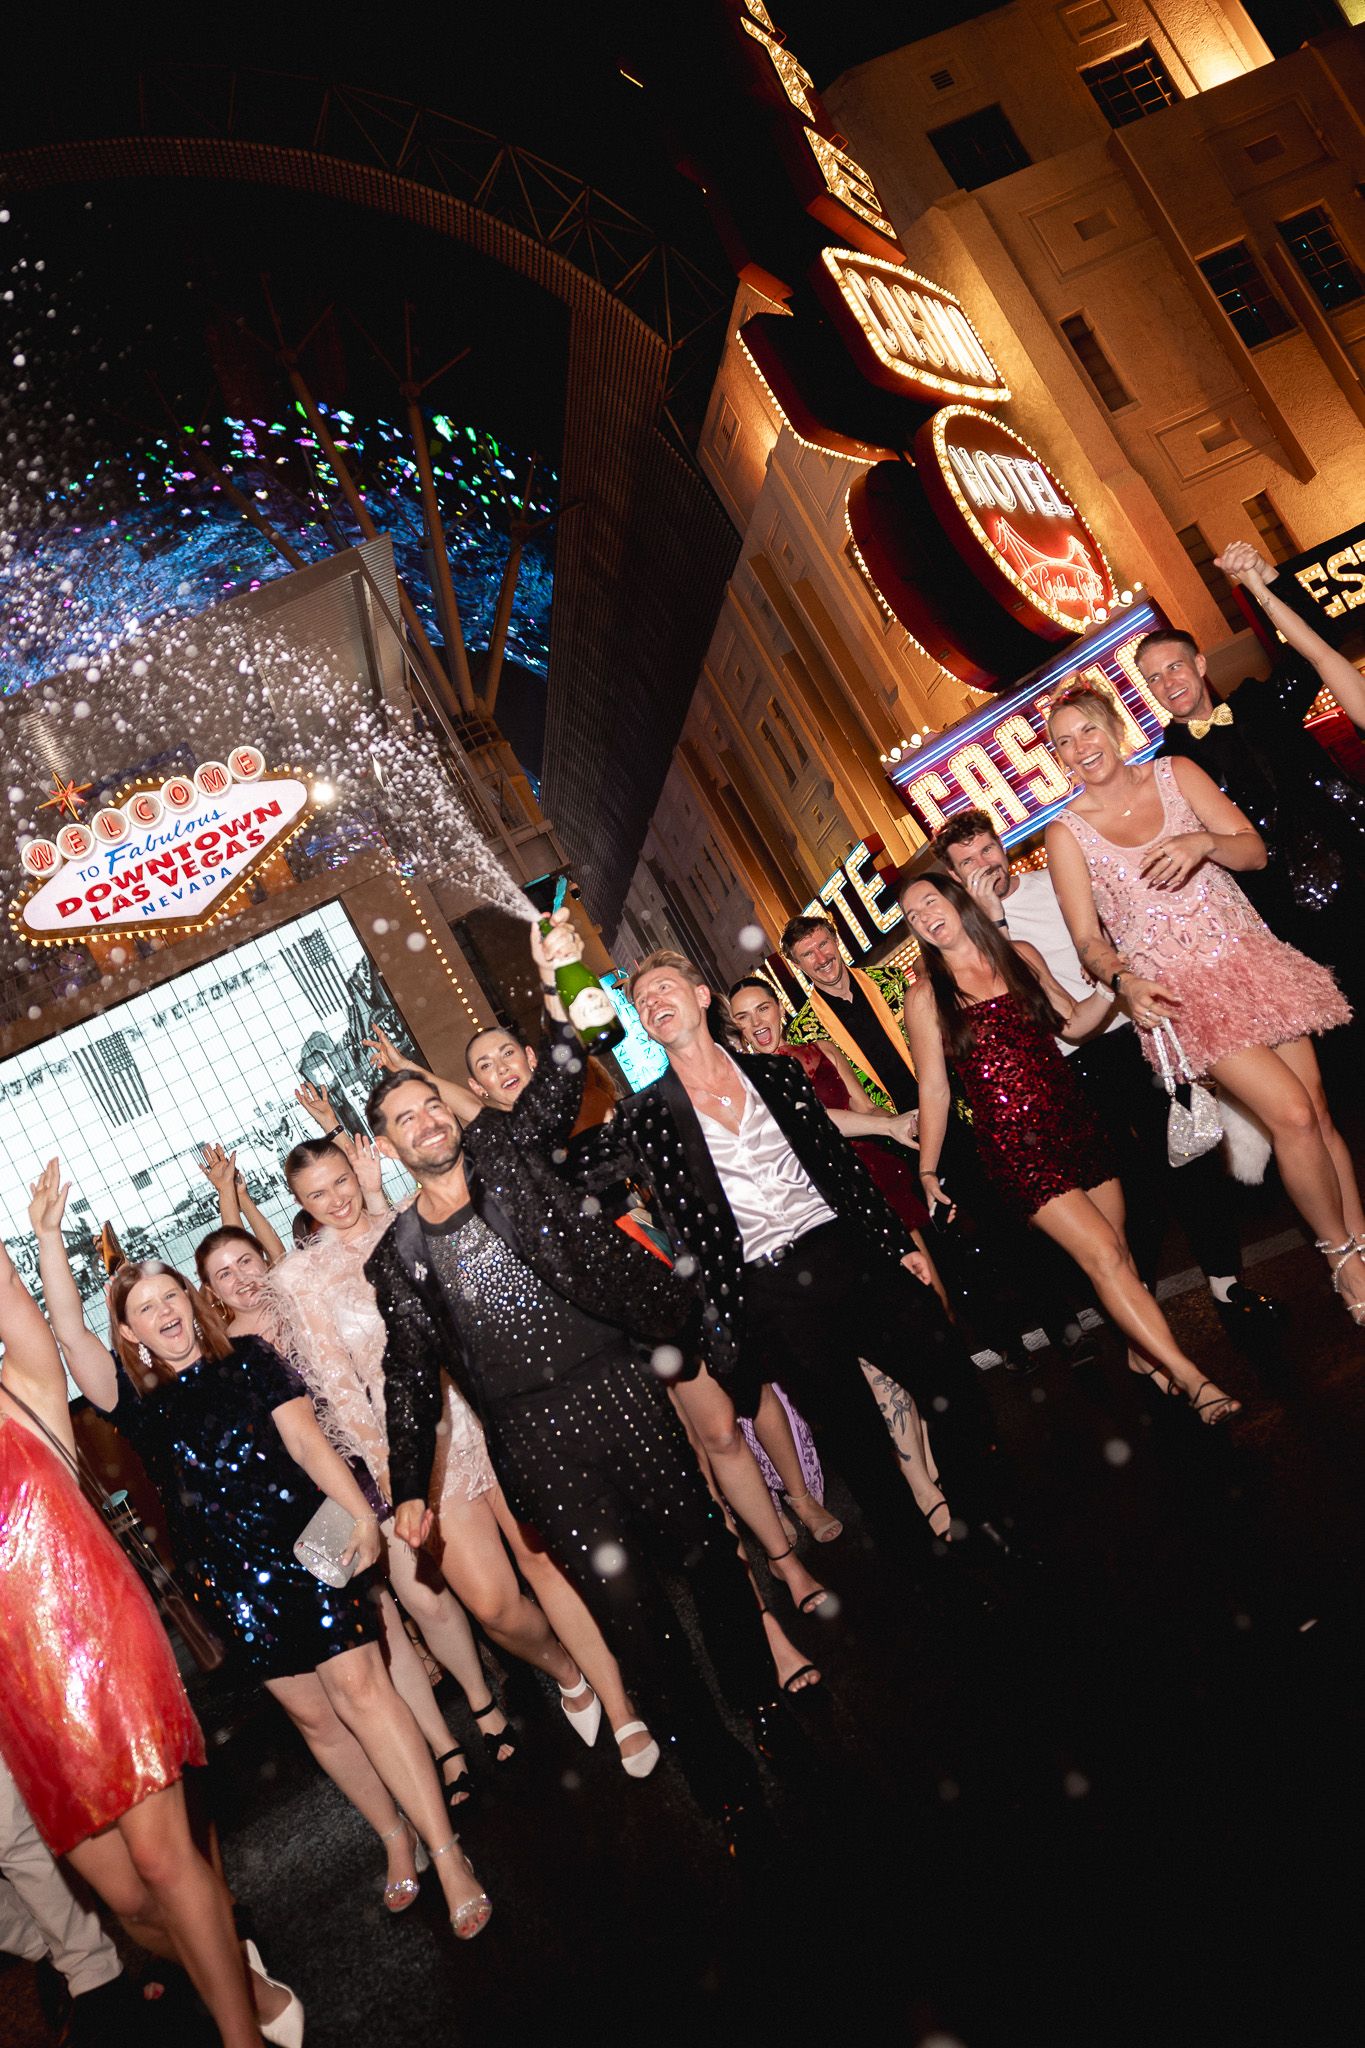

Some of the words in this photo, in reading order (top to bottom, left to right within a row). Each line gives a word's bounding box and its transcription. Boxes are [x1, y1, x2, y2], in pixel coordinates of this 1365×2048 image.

[842, 268, 997, 383] CASINO
[948, 444, 1075, 518] HOTEL
[1040, 566, 1083, 600] Golden
[1076, 570, 1104, 600] Gate
[1294, 539, 1365, 619] ES
[908, 632, 1174, 835] CAS
[28, 752, 257, 871] WELCOME
[76, 864, 101, 883] TO
[104, 808, 226, 876] Fabulous
[55, 800, 283, 919] DOWNTOWN
[90, 883, 151, 923] LAS
[158, 829, 266, 888] VEGAS
[141, 866, 232, 916] NEVADA
[278, 1100, 300, 1114] GARA
